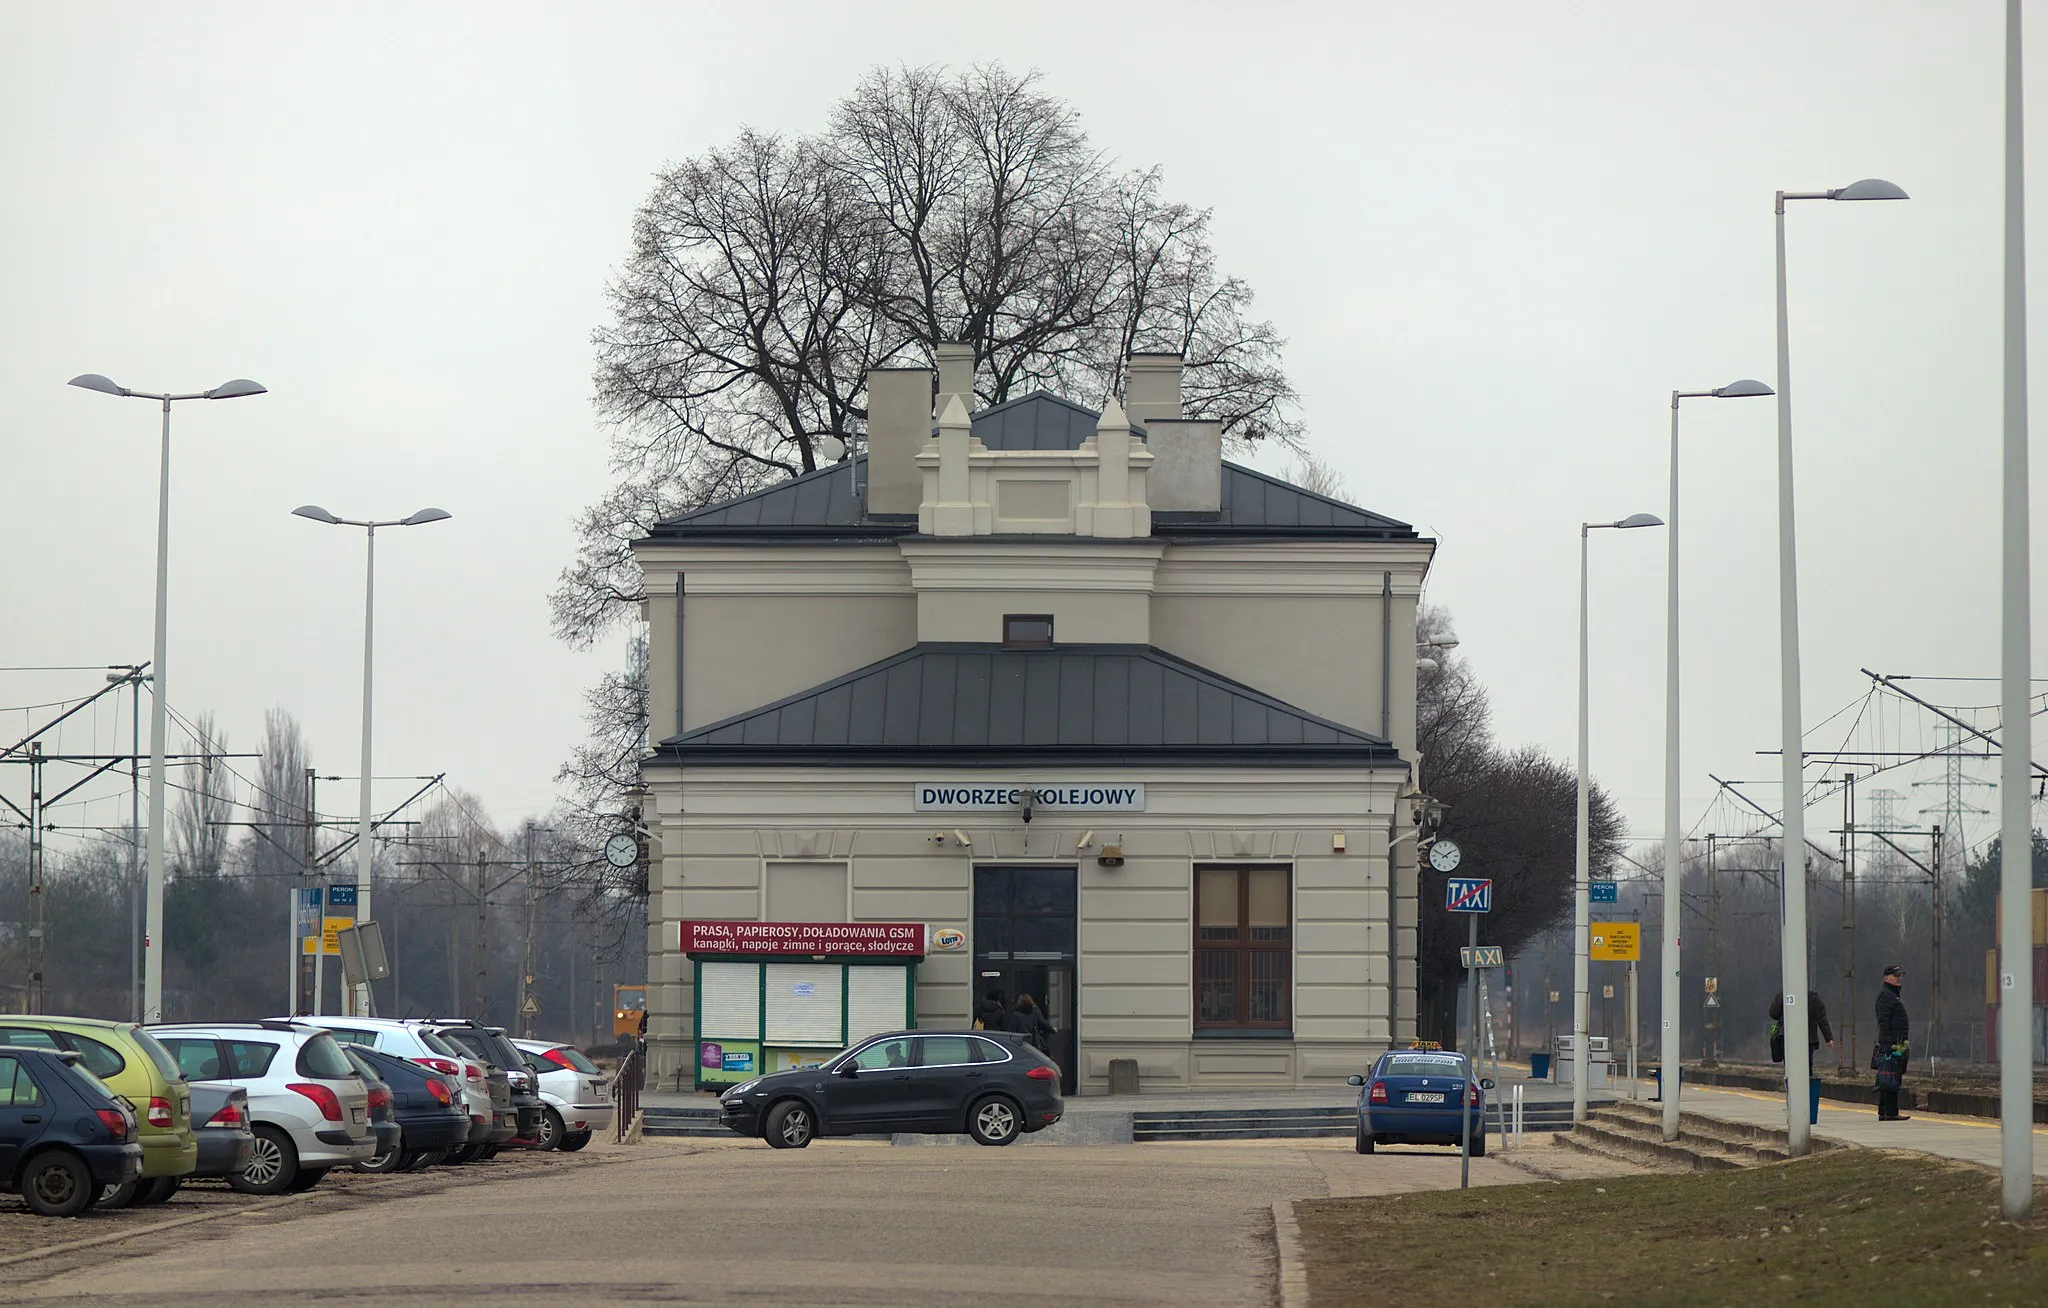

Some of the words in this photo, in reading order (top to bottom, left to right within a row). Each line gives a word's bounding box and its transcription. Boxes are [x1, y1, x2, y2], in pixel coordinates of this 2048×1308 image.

[922, 789, 1020, 805] DWORZEC
[1031, 789, 1137, 805] KOLEJOWY
[1449, 883, 1488, 908] TAXI
[693, 925, 733, 938] PRASA,
[736, 926, 802, 939] PAPIEROSY,
[803, 927, 886, 938] DOŁADOWANIA
[889, 927, 914, 938] GSM
[693, 938, 739, 952] kanapki,
[742, 939, 779, 952] napoje
[783, 939, 816, 950] zimne
[818, 939, 822, 950] i
[825, 940, 866, 953] gorące,
[868, 940, 914, 952] słodycze
[941, 936, 959, 945] LOTTO
[1462, 949, 1502, 966] TAXI
[1409, 1093, 1419, 1101] EL
[1421, 1093, 1443, 1102] 029SP
